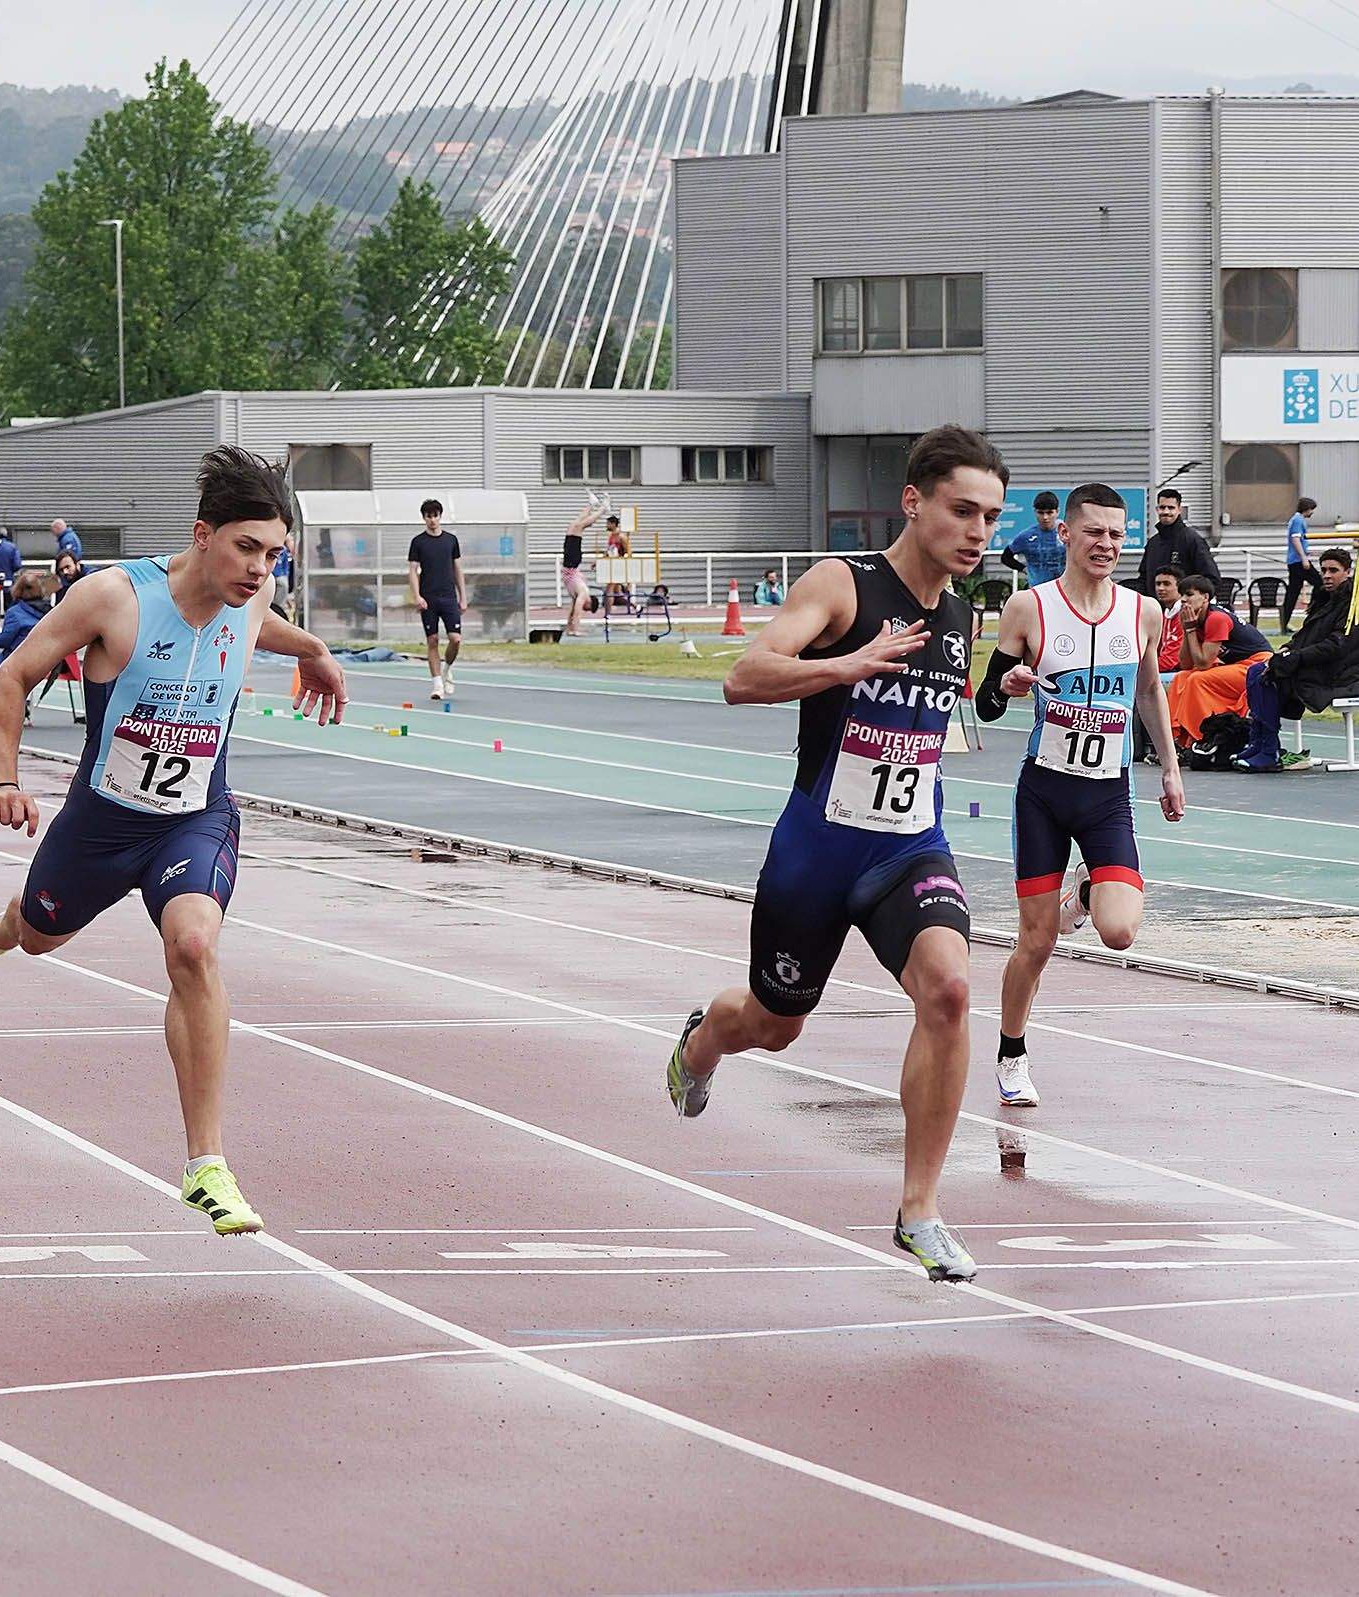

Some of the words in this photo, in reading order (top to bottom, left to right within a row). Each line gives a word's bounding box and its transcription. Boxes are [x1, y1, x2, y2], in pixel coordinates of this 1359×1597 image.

[1329, 374, 1359, 392] XU
[1329, 400, 1359, 418] DE
[147, 651, 172, 661] ZICO
[149, 682, 198, 693] CONCELLO
[151, 692, 162, 700] DE
[167, 693, 190, 701] VIGO
[851, 679, 957, 713] NARÓ
[1047, 702, 1126, 724] PONTEVEDRA
[121, 717, 217, 744] PONTEVEDRA
[1072, 719, 1102, 733] 2025
[846, 722, 942, 751] PONTEVEDRA
[150, 738, 187, 754] 2025
[1064, 731, 1106, 768] 10
[881, 747, 919, 764] 2025
[139, 751, 191, 799] 12
[871, 763, 920, 814] 13
